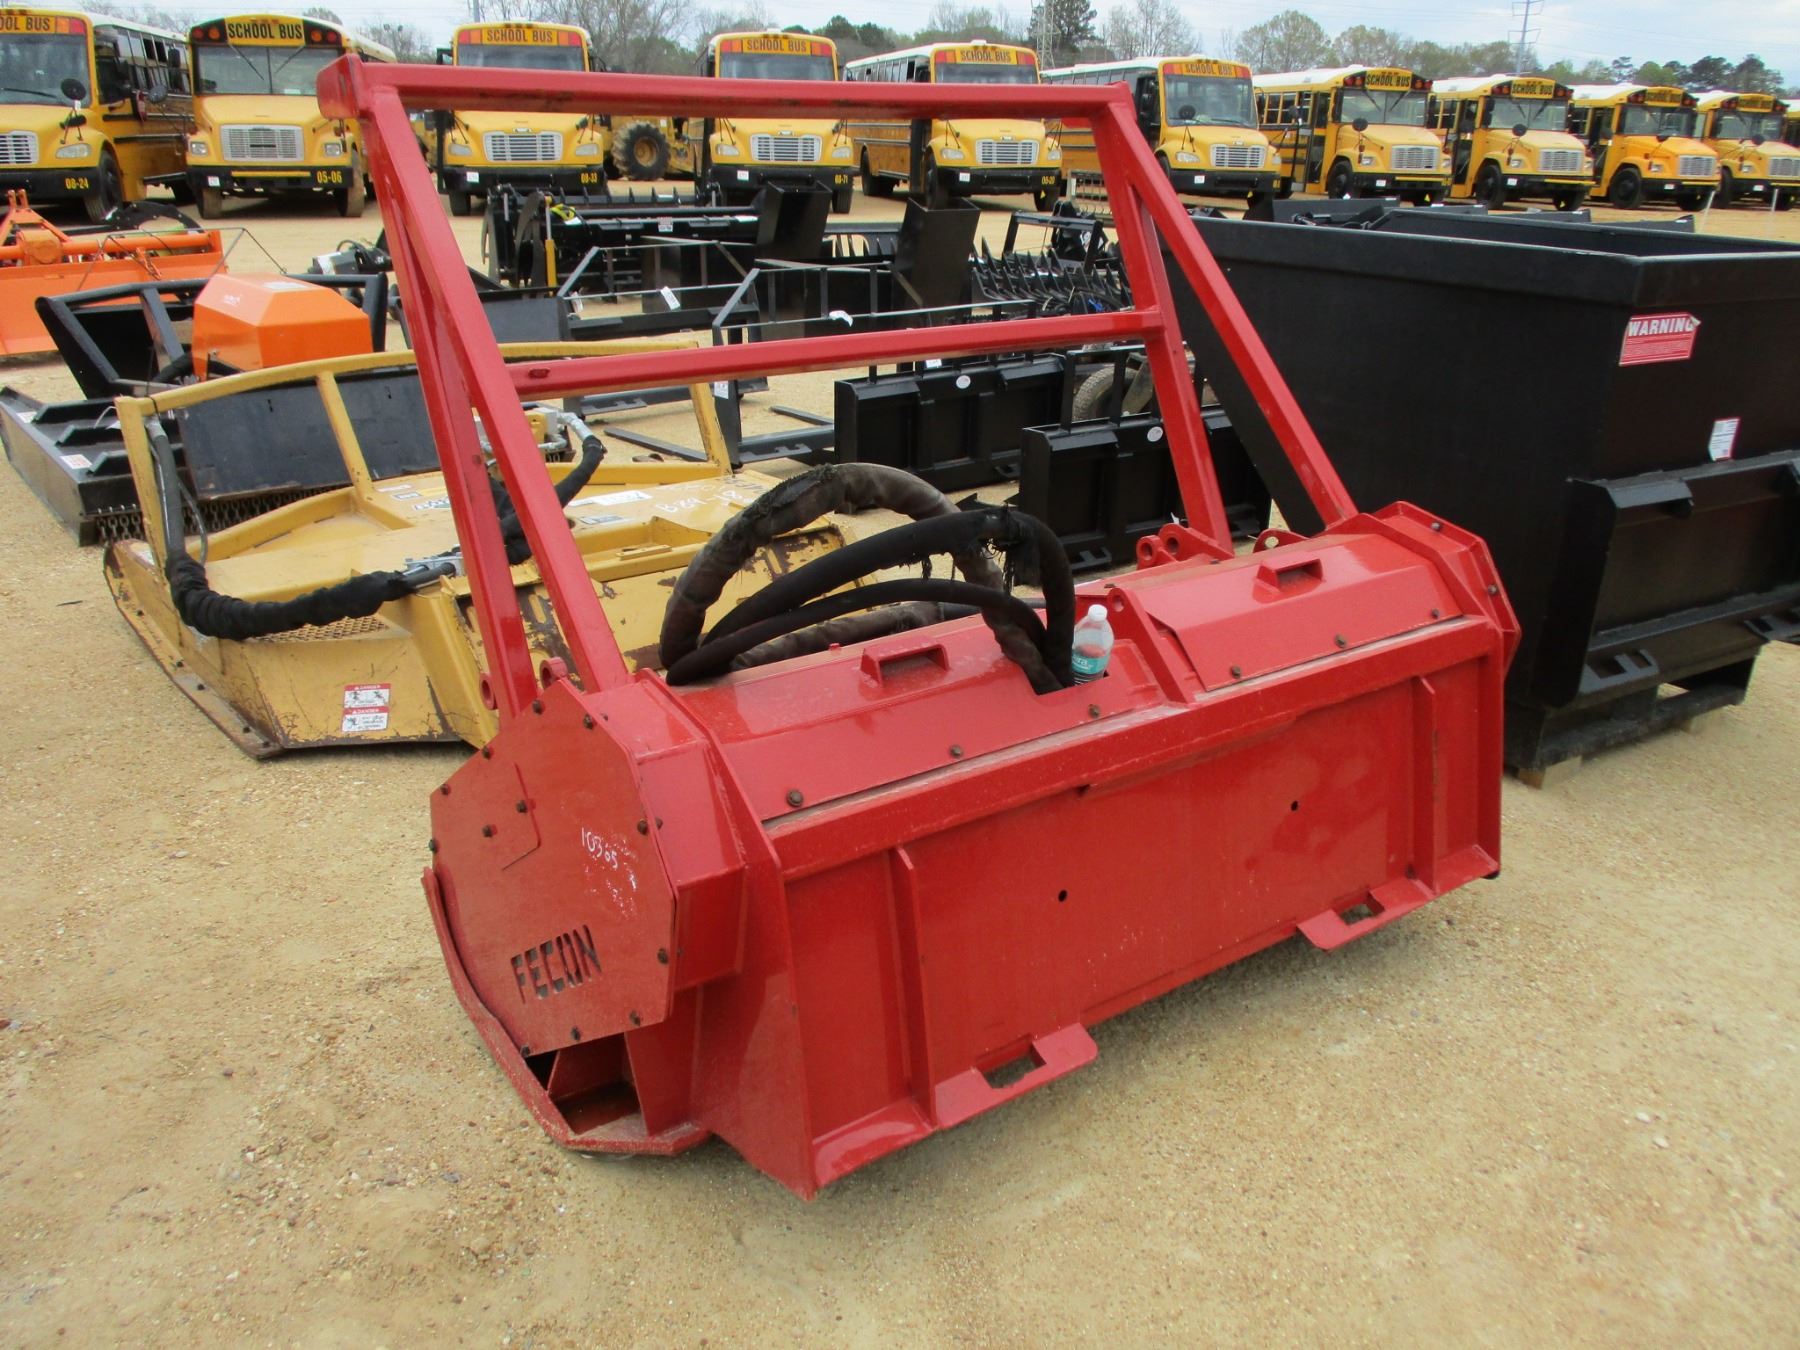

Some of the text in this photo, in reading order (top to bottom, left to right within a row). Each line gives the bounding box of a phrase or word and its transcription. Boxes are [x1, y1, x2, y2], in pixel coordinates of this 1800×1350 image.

[26, 17, 50, 31] BUS
[228, 23, 303, 39] SCHOOL BUS
[487, 29, 553, 42] SCHOOL BUS
[747, 40, 807, 52] SCHOOL BUS
[960, 50, 1011, 62] SCHOOL BUS
[1185, 63, 1233, 75] SCHOOL BUS
[1366, 74, 1410, 87] SCHOOL BUS
[1627, 317, 1695, 336] WARNING
[510, 924, 602, 1004] FECON
